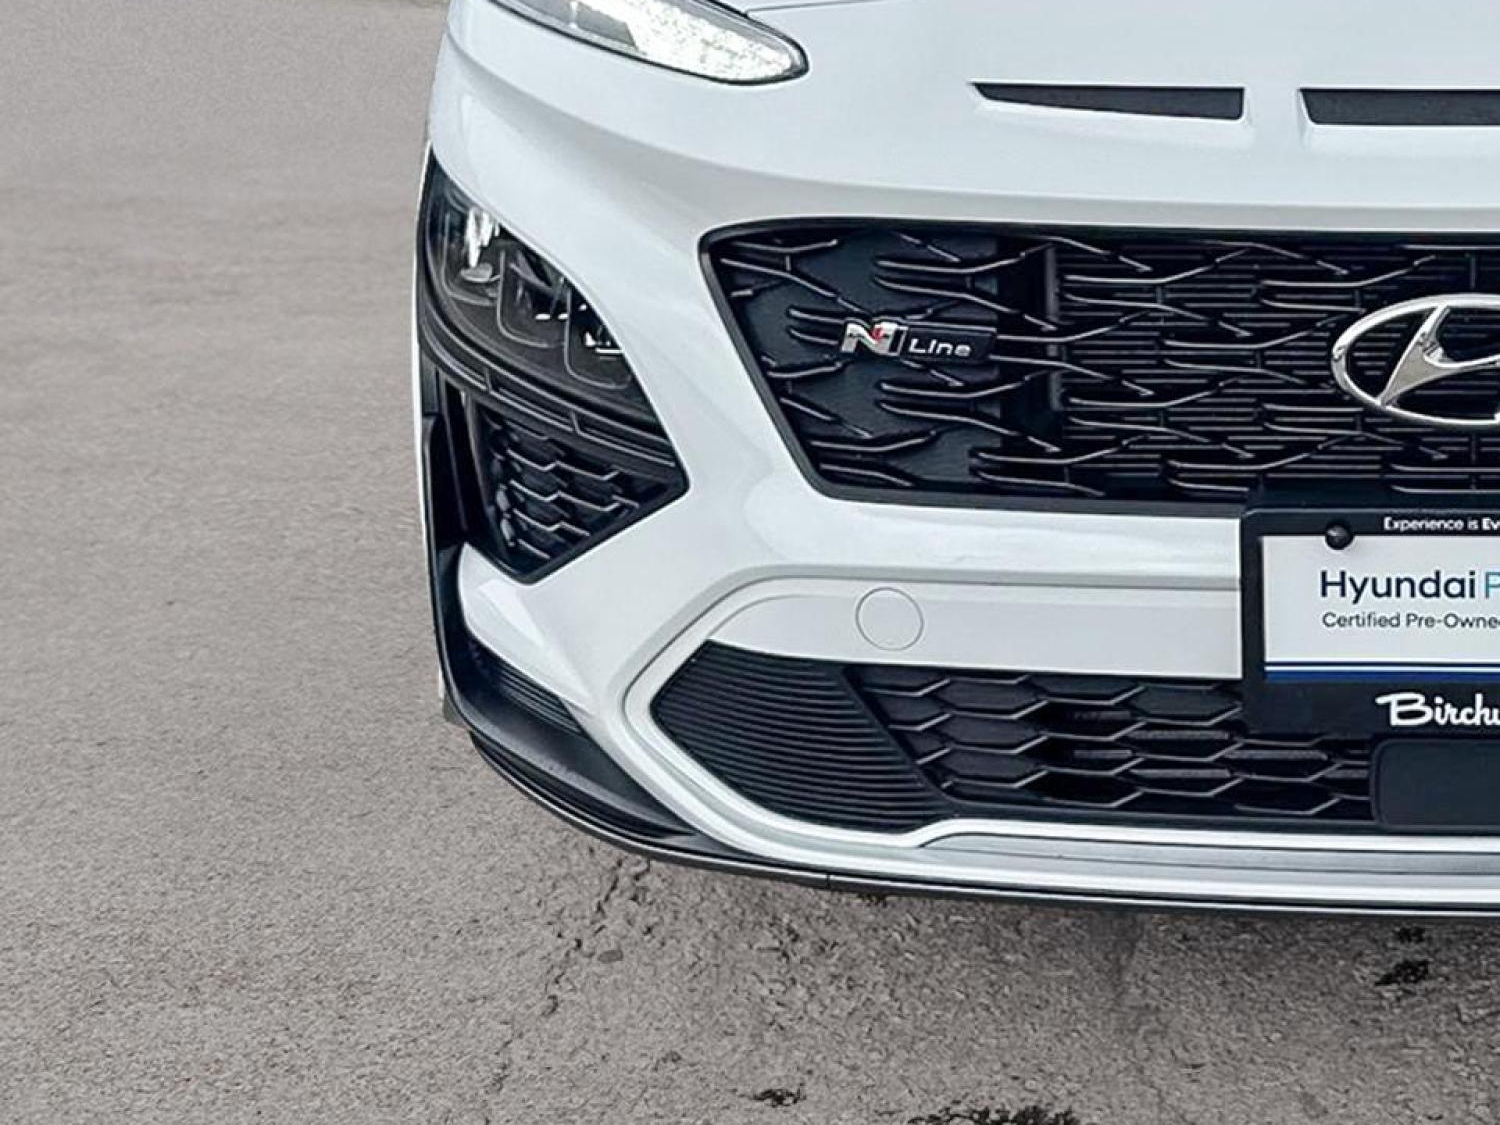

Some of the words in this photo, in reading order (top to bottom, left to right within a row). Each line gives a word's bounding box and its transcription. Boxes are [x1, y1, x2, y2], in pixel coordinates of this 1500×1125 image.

[909, 338, 972, 357] Line
[1384, 516, 1464, 532] Experience
[1468, 517, 1478, 531] is
[1320, 570, 1476, 604] Hyundai
[1322, 612, 1401, 629] Certified
